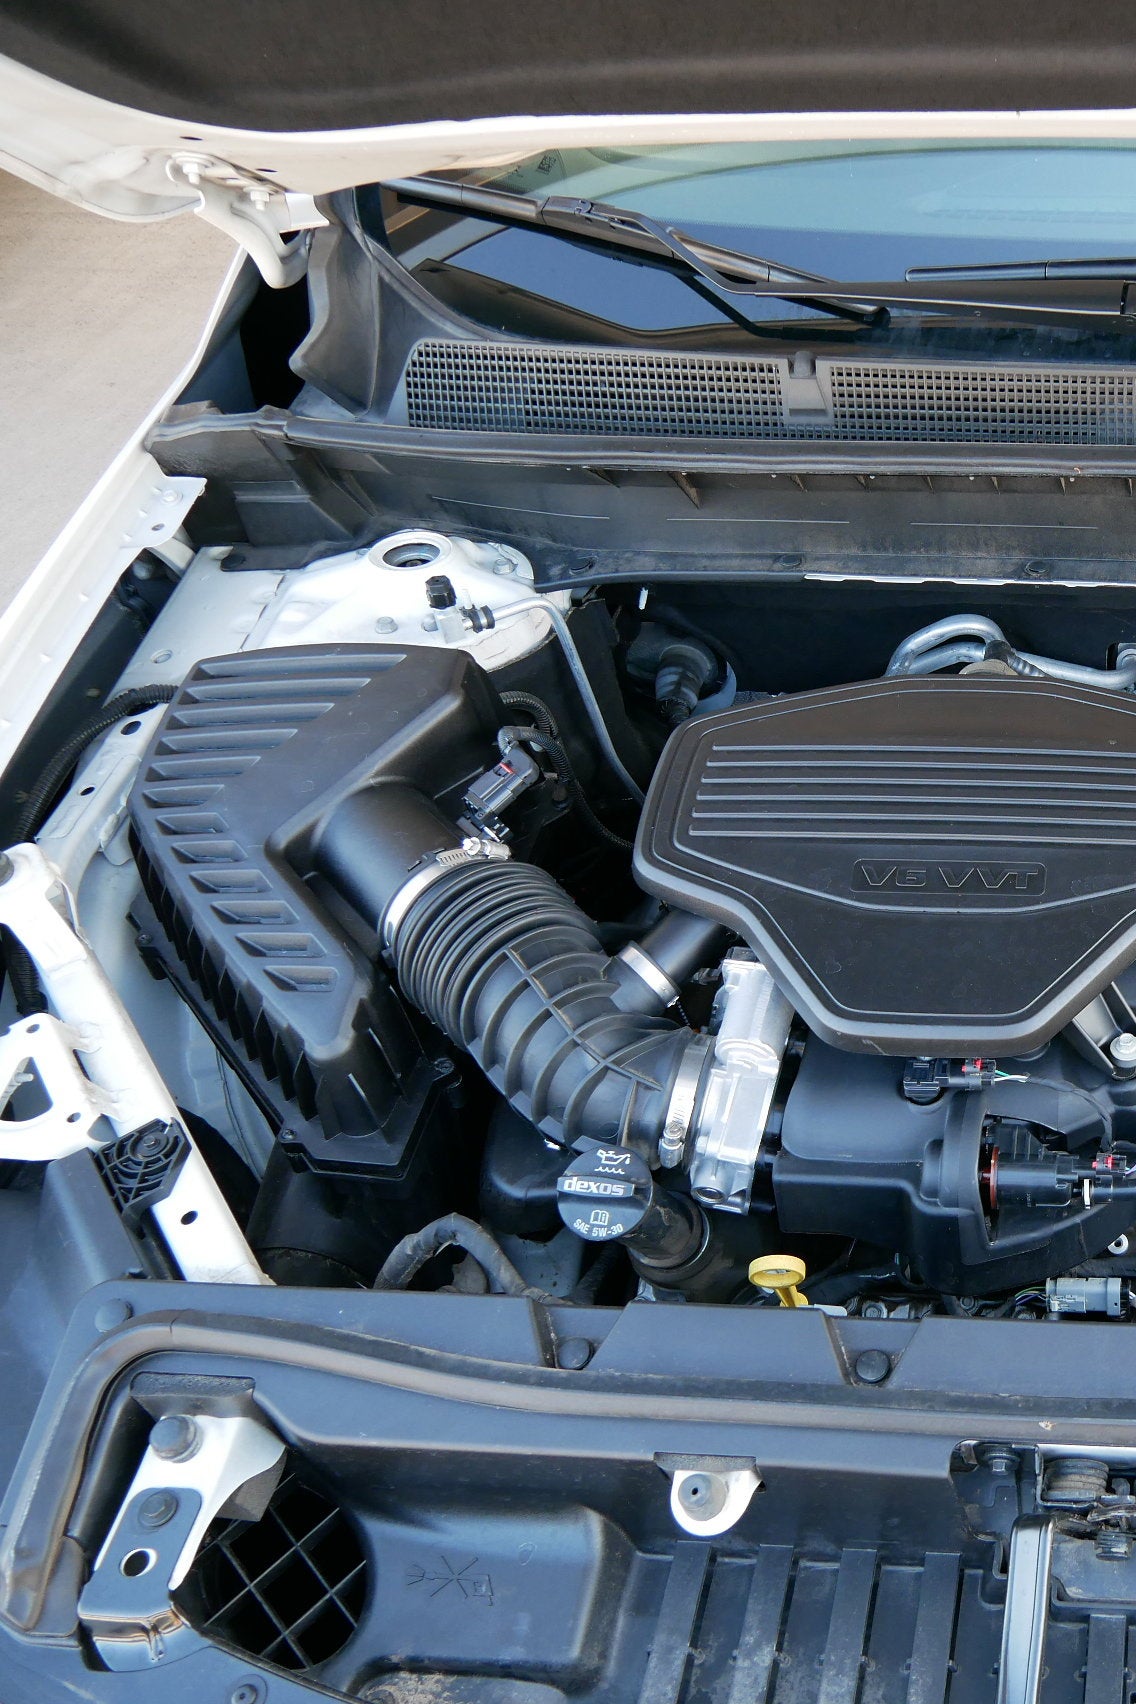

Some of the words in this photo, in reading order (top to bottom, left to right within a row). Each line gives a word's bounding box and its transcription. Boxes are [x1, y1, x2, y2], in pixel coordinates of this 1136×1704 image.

[861, 865, 927, 887] V6
[938, 867, 1039, 889] VVT
[564, 1177, 625, 1196] dexos
[573, 1218, 590, 1234] SAE
[591, 1223, 624, 1237] 5W-30
